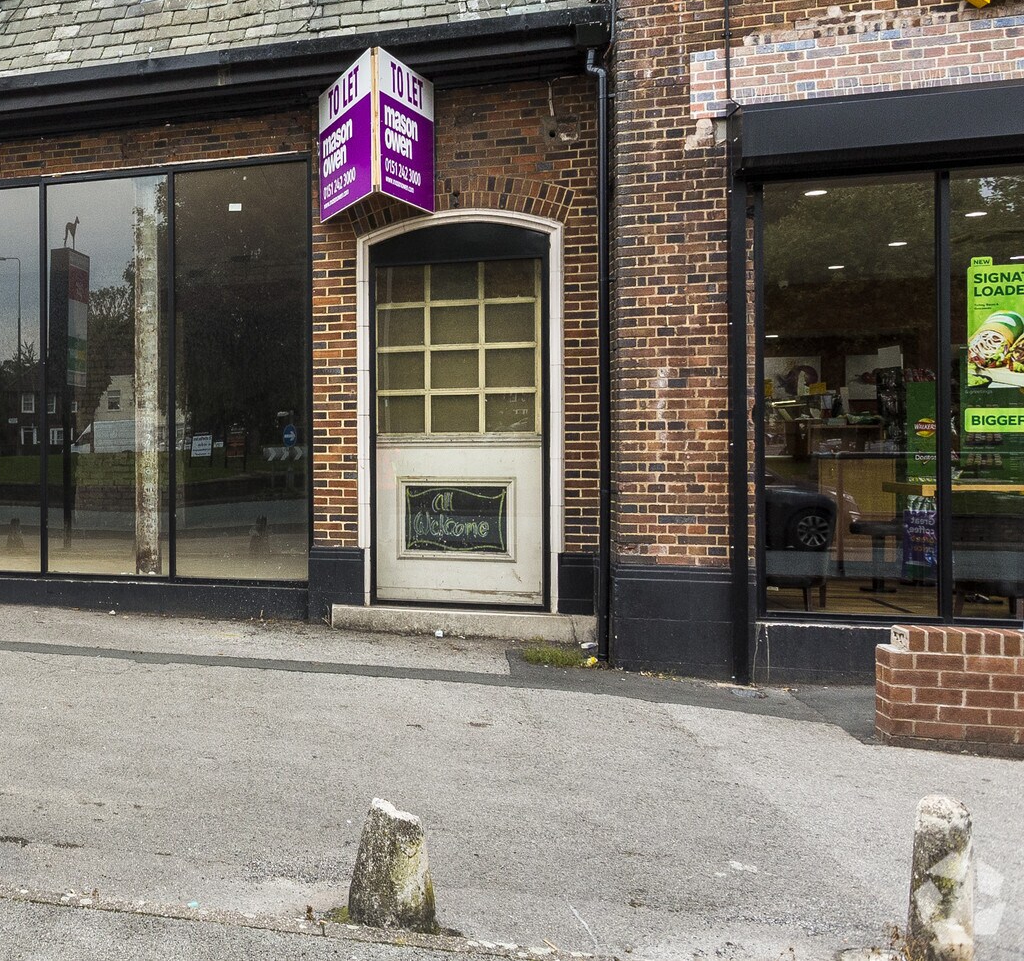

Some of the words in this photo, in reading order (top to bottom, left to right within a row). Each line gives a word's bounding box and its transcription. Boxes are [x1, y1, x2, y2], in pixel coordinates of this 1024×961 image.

[328, 84, 339, 119] TO
[343, 65, 359, 108] LET
[391, 61, 403, 97] TO
[407, 72, 423, 110] LET
[322, 118, 352, 158] mason
[384, 104, 418, 142] mason
[323, 144, 347, 178] owen
[385, 127, 412, 160] owen
[385, 157, 398, 176] 0151
[398, 163, 408, 181] 242
[409, 168, 421, 187] 3000
[414, 511, 489, 537] Welcome
